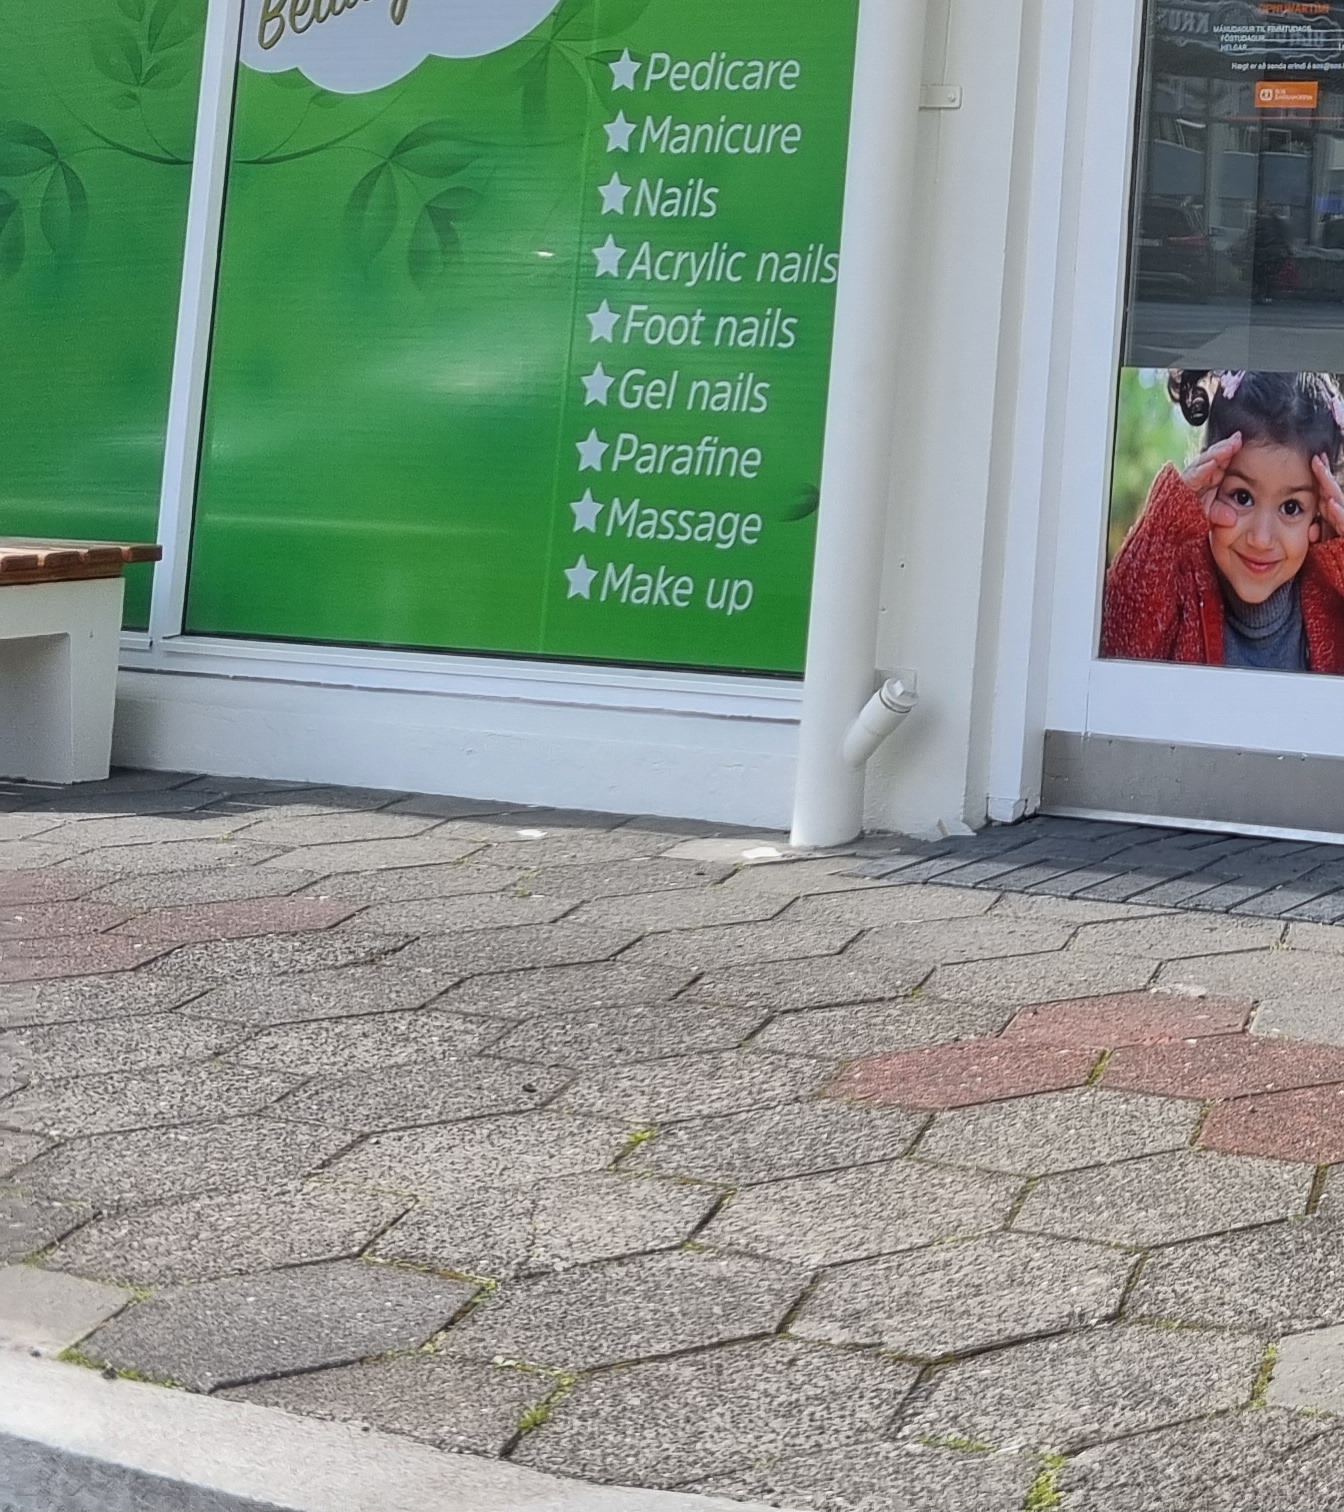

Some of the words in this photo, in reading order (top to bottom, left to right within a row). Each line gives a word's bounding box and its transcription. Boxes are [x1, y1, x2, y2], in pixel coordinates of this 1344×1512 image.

[644, 52, 800, 91] Pedicare
[640, 115, 802, 154] Manicure
[634, 178, 719, 218] Nails
[627, 241, 747, 287] Acrylic
[756, 243, 840, 283] nails
[622, 304, 706, 346] Foot
[714, 307, 798, 349] nails
[618, 368, 679, 410] Gel
[686, 372, 770, 413] nails
[611, 433, 762, 479] Parafine
[606, 497, 762, 549] Massage
[600, 562, 694, 607] Make
[706, 578, 753, 616] up
